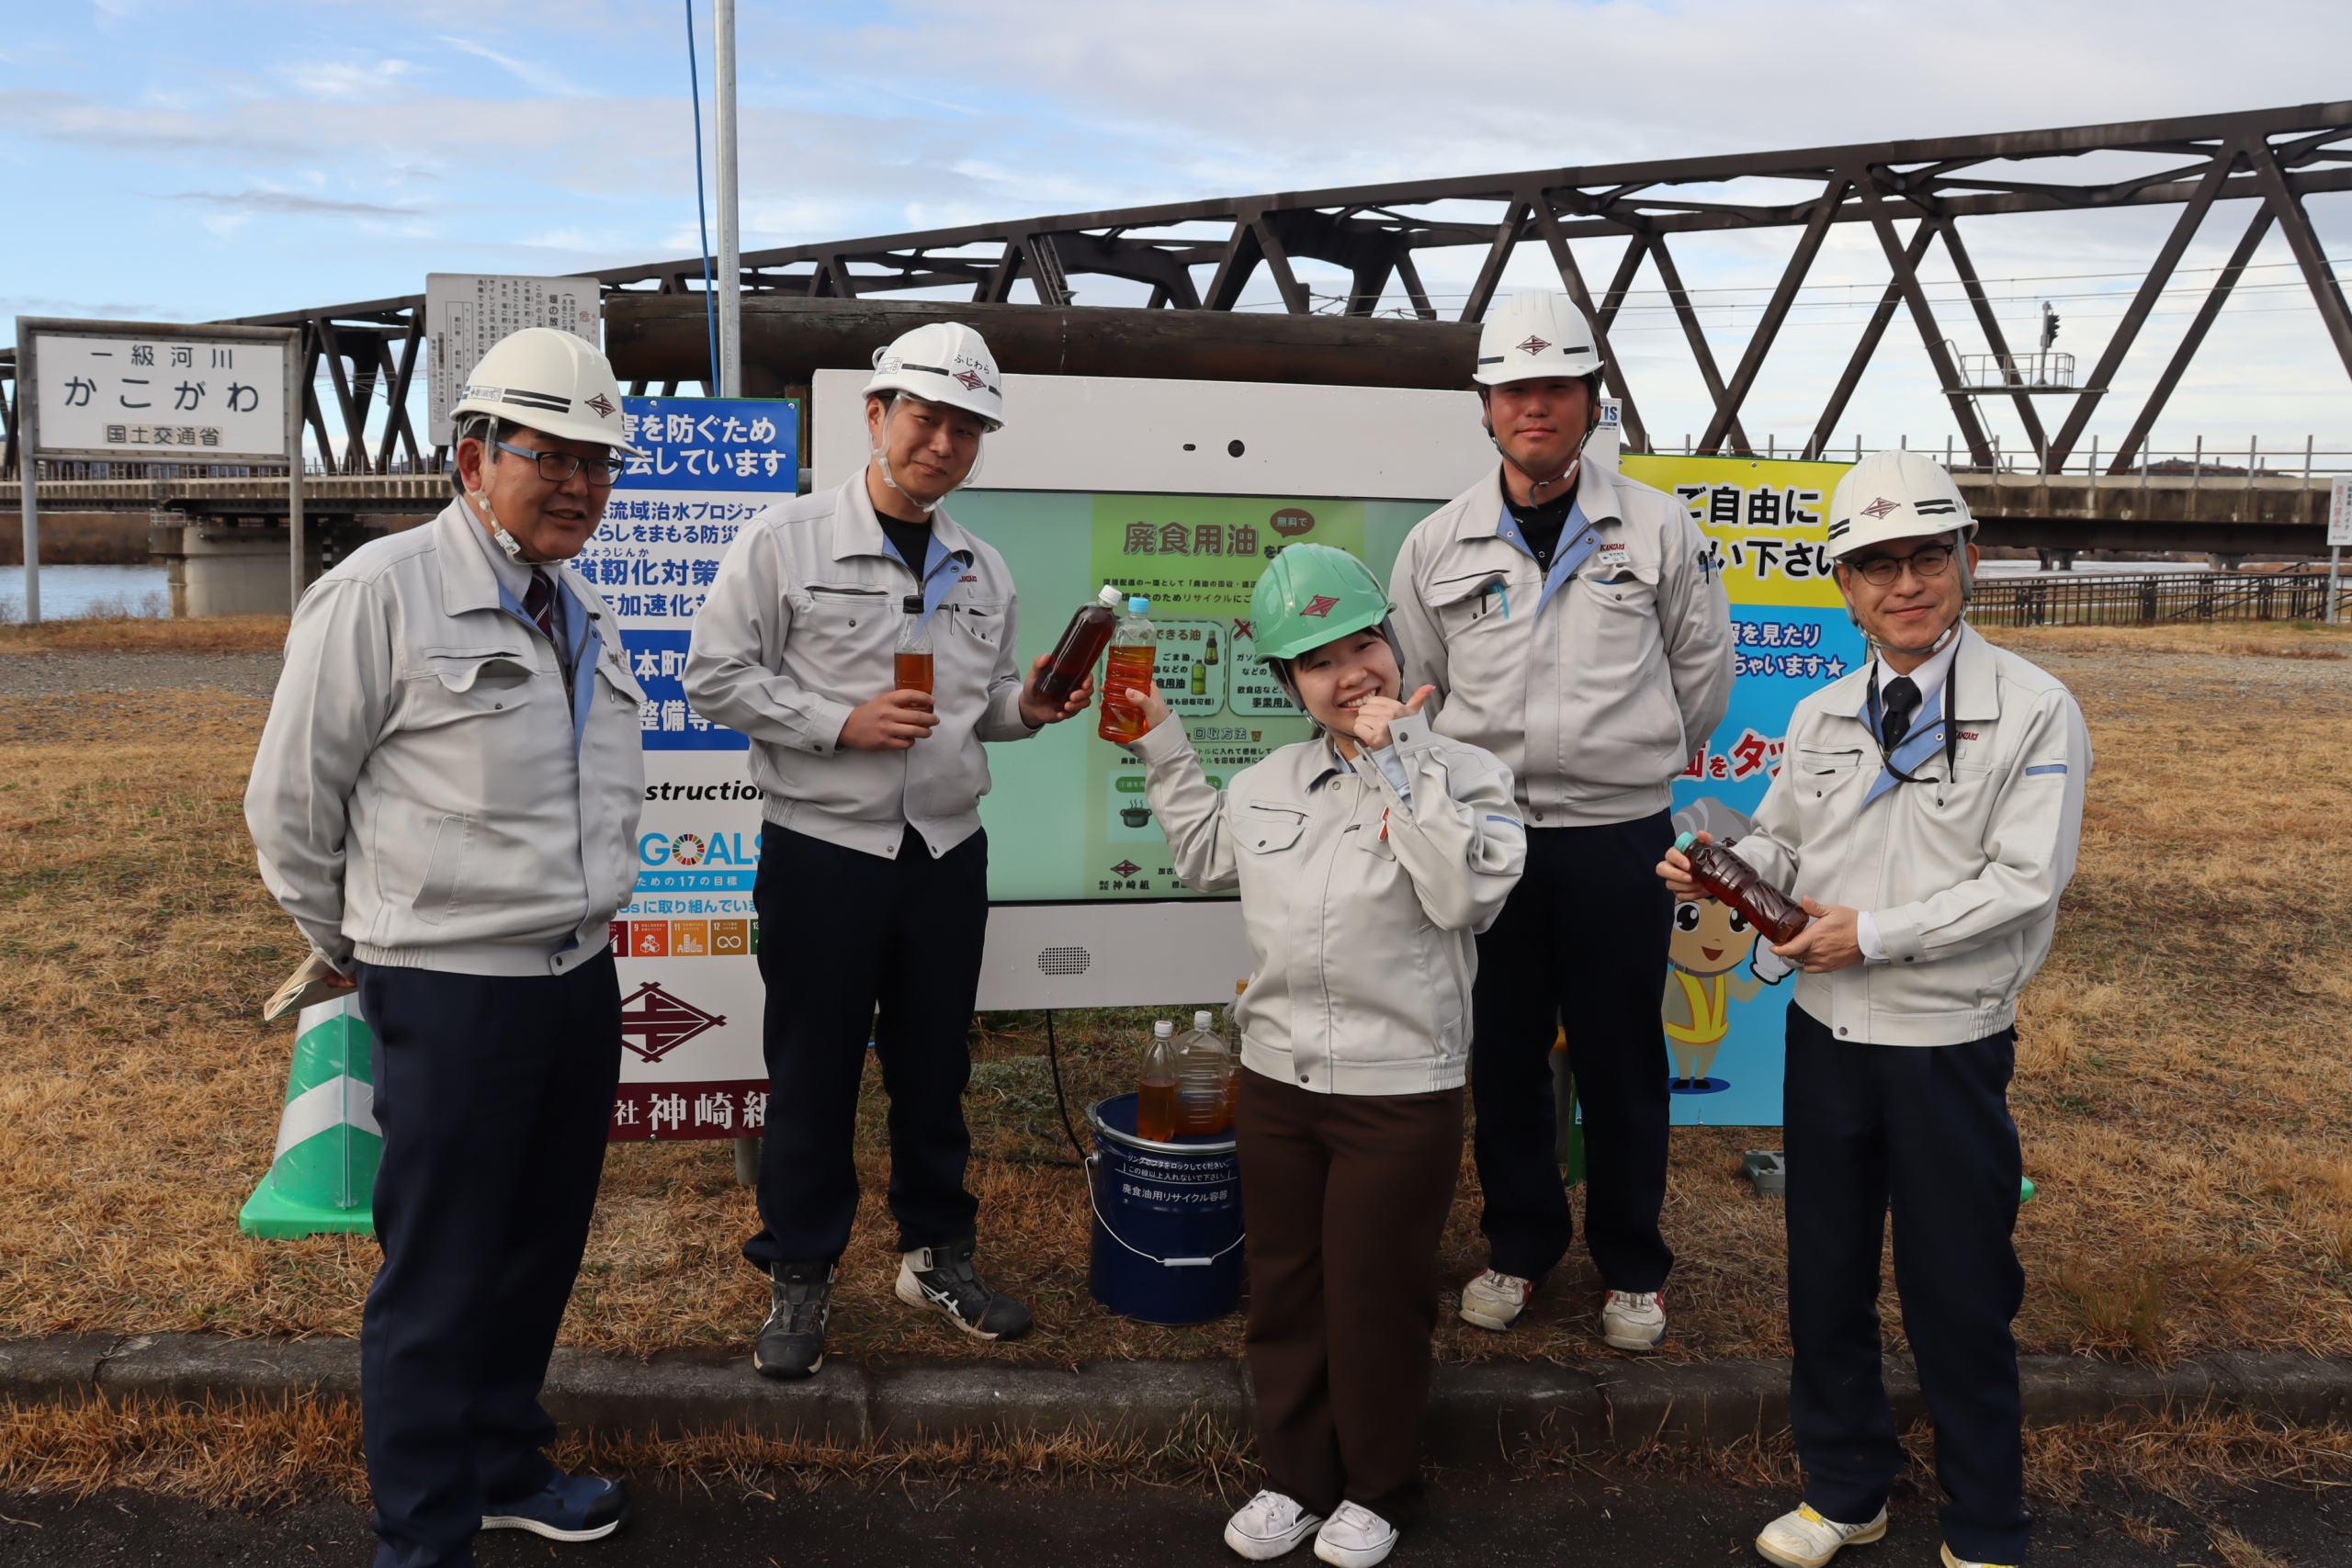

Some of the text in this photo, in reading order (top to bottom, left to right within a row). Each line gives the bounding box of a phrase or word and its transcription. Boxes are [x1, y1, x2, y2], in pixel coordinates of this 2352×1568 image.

[91, 344, 232, 369] 一級河川
[955, 355, 990, 375] ふじわら
[63, 376, 259, 412] かこがわ
[106, 424, 220, 446] 国土交通省
[622, 446, 787, 478] 去しています
[601, 501, 768, 522] 流域治水プロジェ
[1677, 486, 1819, 525] ご自由に
[1277, 516, 1308, 527] 無料で
[1123, 520, 1259, 557] 廃食用油
[1600, 543, 1625, 552] KANZAKI
[580, 547, 650, 558] きょうじんか
[626, 649, 686, 682] 本町
[1242, 667, 1272, 677] などの
[1155, 678, 1186, 689] 食用油
[1194, 727, 1248, 740] 回収方法
[634, 923, 639, 932] 9
[673, 923, 681, 931] 11
[713, 922, 720, 931] 12
[1122, 1183, 1227, 1203] 廃食油用リサイクル容器
